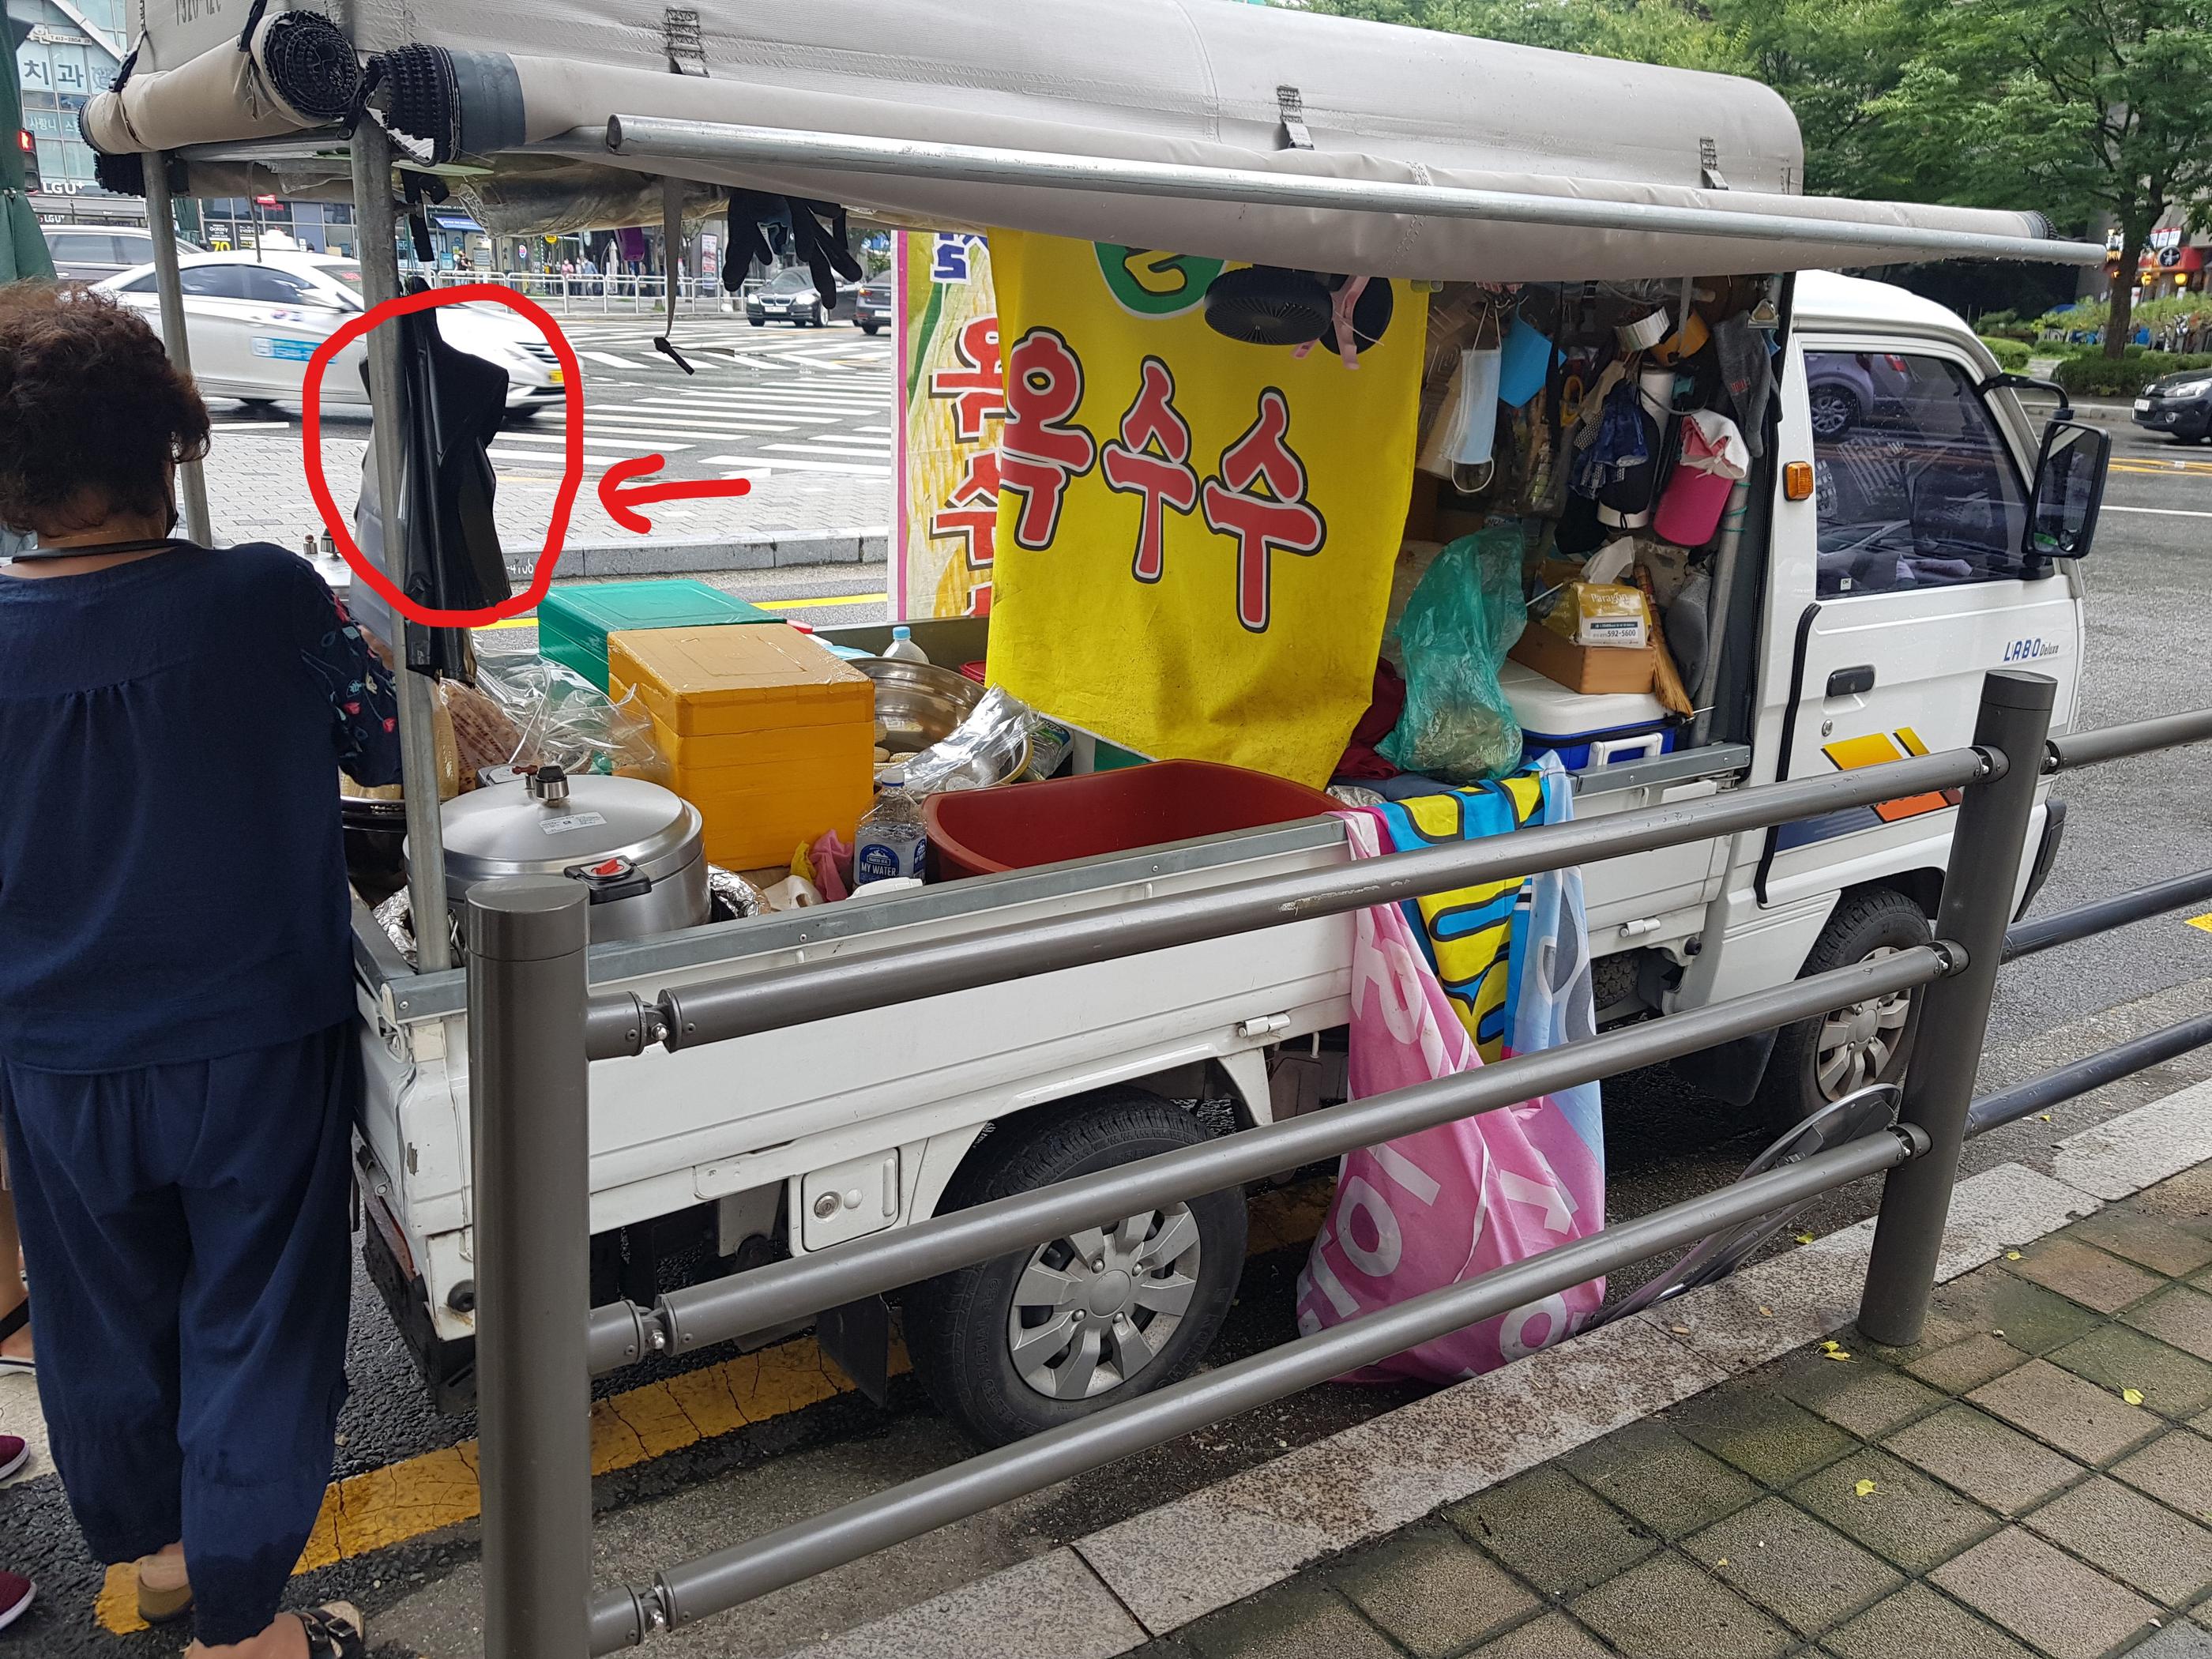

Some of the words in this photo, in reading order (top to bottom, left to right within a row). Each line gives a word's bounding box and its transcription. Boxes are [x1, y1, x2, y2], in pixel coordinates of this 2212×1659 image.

[24, 60, 85, 88] 치과
[29, 116, 57, 131] 사랑니
[999, 325, 1327, 634] 옥수수
[1590, 592, 1627, 604] Paragon
[1607, 629, 1636, 638] 592-5600
[2003, 638, 2041, 661] LABO
[2040, 641, 2060, 656] Deluxe
[861, 862, 871, 873] MY
[872, 864, 897, 877] WATER
